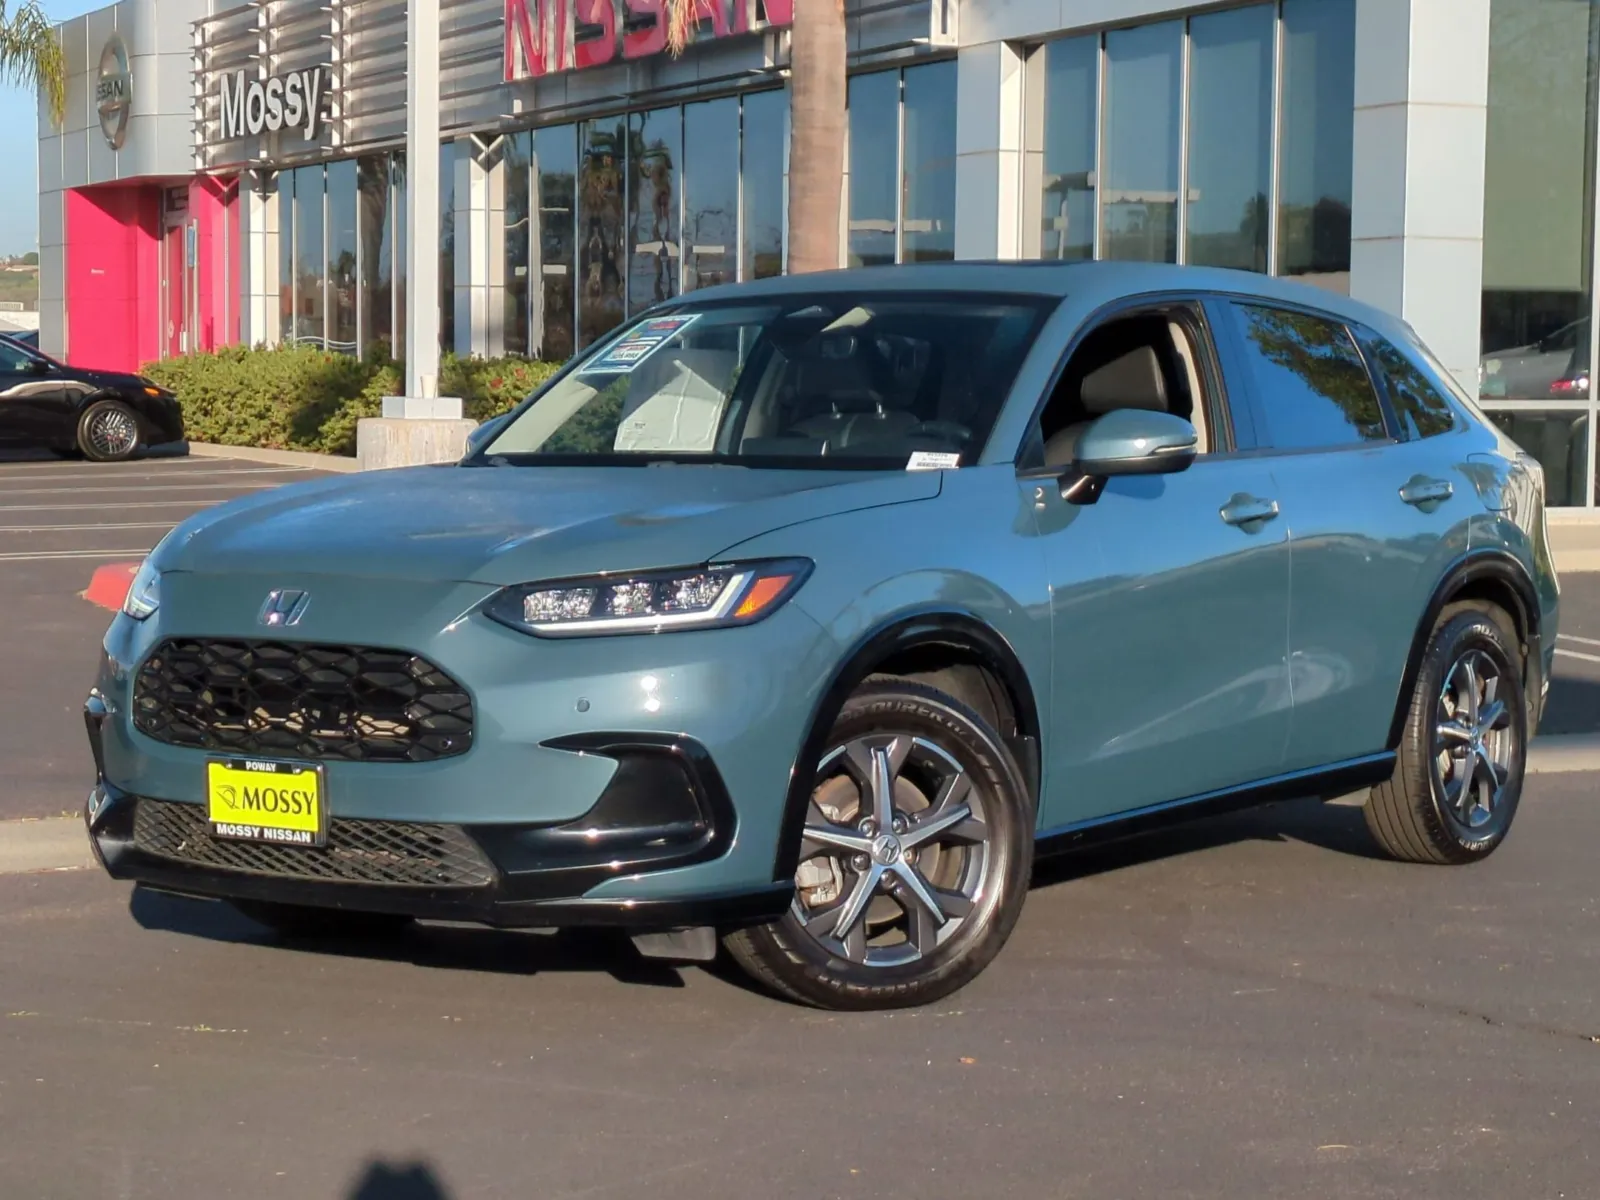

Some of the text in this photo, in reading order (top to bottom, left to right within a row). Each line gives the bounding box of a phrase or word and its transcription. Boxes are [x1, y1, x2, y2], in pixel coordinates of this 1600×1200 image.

[219, 67, 321, 141] Mossy
[245, 761, 277, 772] POWAY
[242, 786, 315, 815] MOSSY
[216, 823, 311, 843] MOSSY NISSAN
